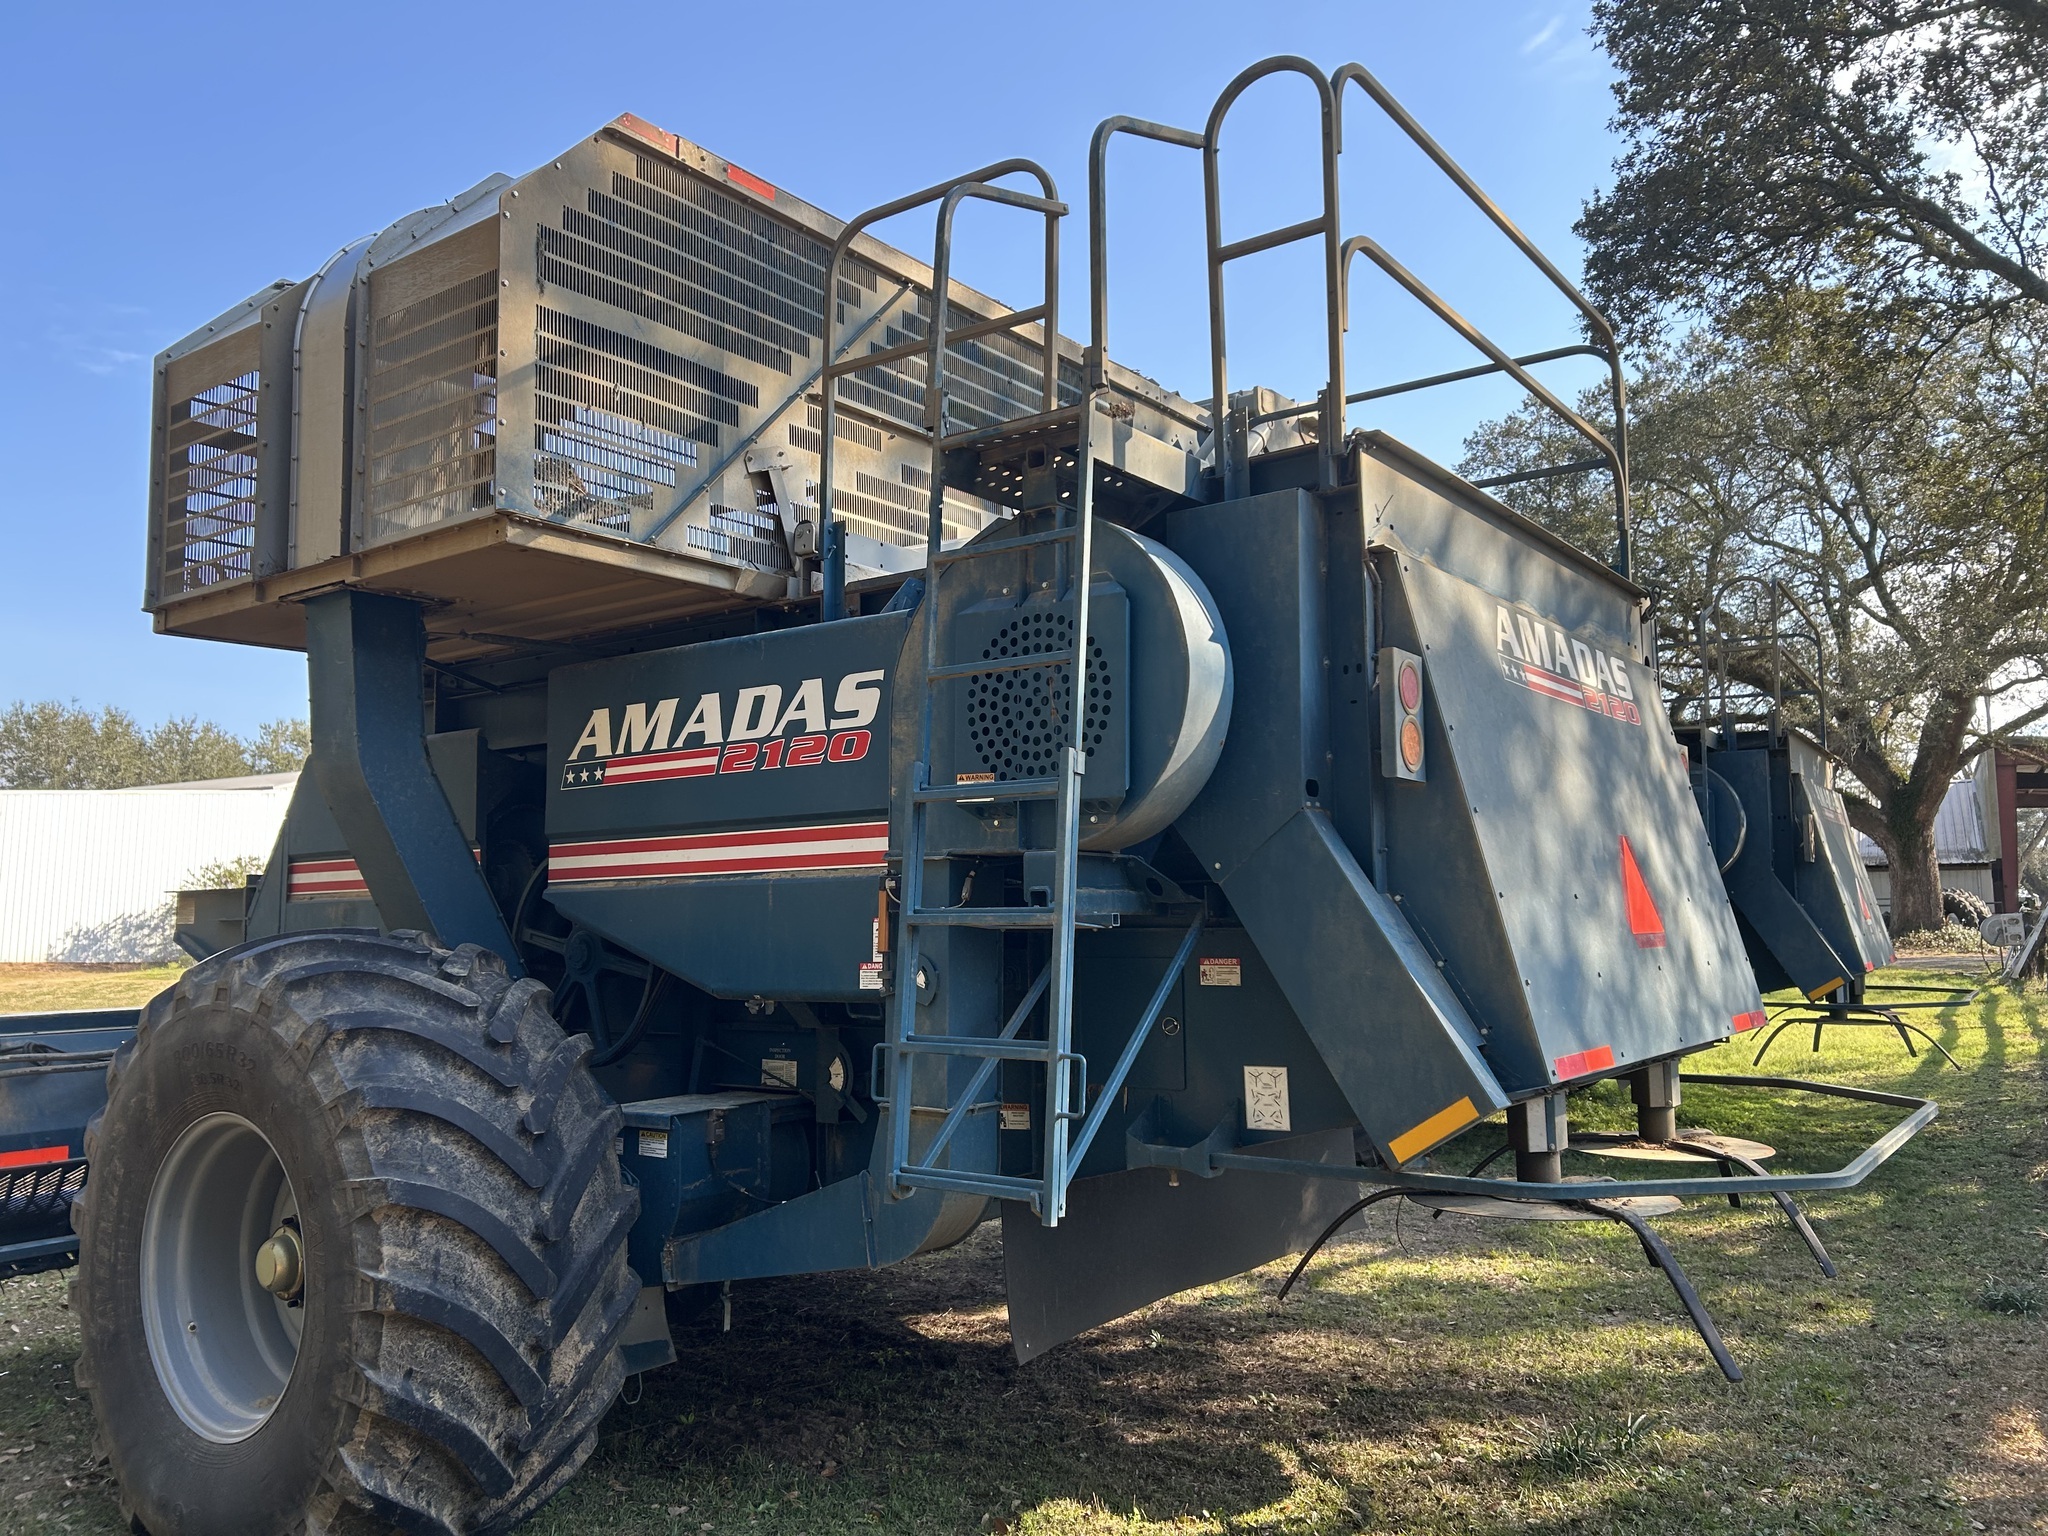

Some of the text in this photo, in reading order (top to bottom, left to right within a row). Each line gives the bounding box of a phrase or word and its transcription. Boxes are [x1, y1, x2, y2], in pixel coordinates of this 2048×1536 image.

[1497, 605, 1634, 701] AMADAS
[568, 669, 885, 760] AMADAS
[1581, 684, 1641, 726] 2120
[719, 729, 872, 774] 2120
[965, 773, 994, 781] WARNING
[645, 1131, 667, 1139] CAUTION
